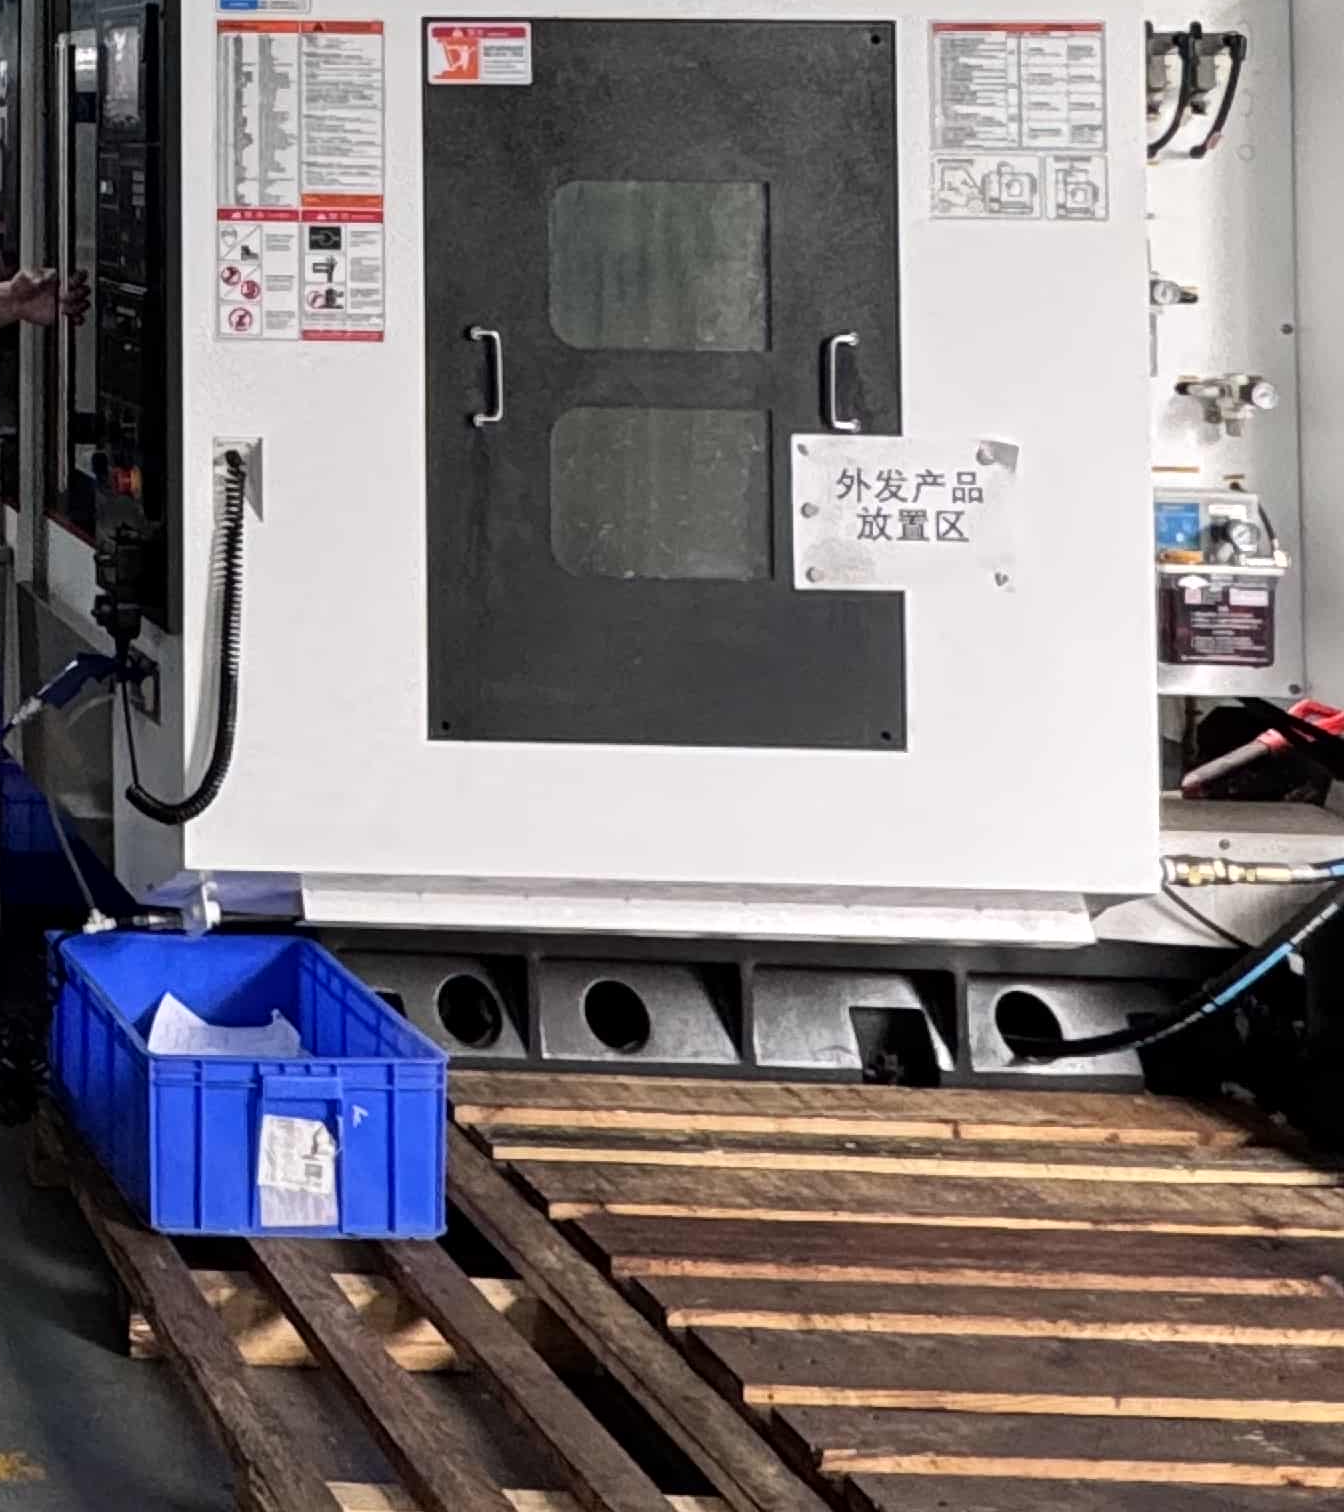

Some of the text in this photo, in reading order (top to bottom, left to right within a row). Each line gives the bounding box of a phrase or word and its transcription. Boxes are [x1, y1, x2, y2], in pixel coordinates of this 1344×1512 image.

[835, 467, 984, 504] 外发产品
[856, 507, 970, 543] 放置区
